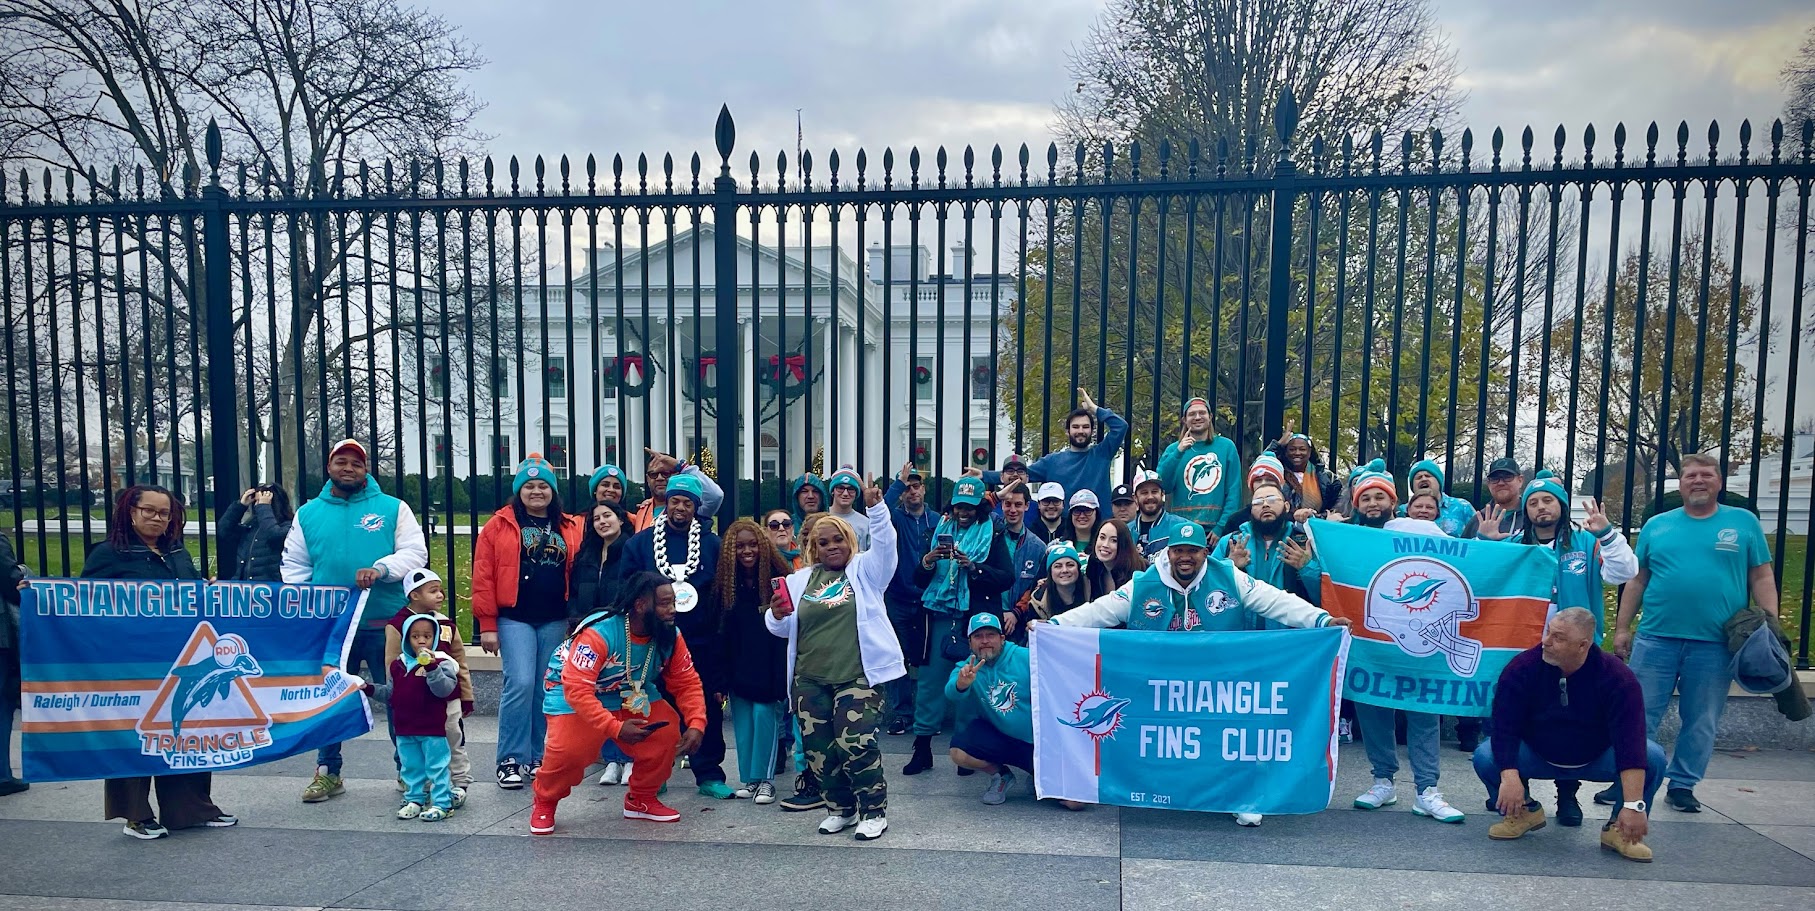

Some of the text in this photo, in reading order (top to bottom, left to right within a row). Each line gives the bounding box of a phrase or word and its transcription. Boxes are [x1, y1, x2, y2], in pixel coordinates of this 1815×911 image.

[1393, 538, 1468, 558] MIAMI
[31, 581, 350, 619] TRIANGLE FINS CLUB
[215, 646, 237, 656] RDU
[574, 652, 592, 668] NFL
[280, 688, 311, 701] North
[1348, 666, 1495, 707] OLPHIN
[33, 694, 81, 711] Raleigh
[90, 693, 141, 707] Durham
[1148, 679, 1289, 715] TRIANGLE
[143, 727, 271, 754] TRIANGLE
[1140, 725, 1293, 762] FINS CLUB
[173, 750, 251, 767] FINS CLUB
[1130, 792, 1171, 804] EST. 2021
